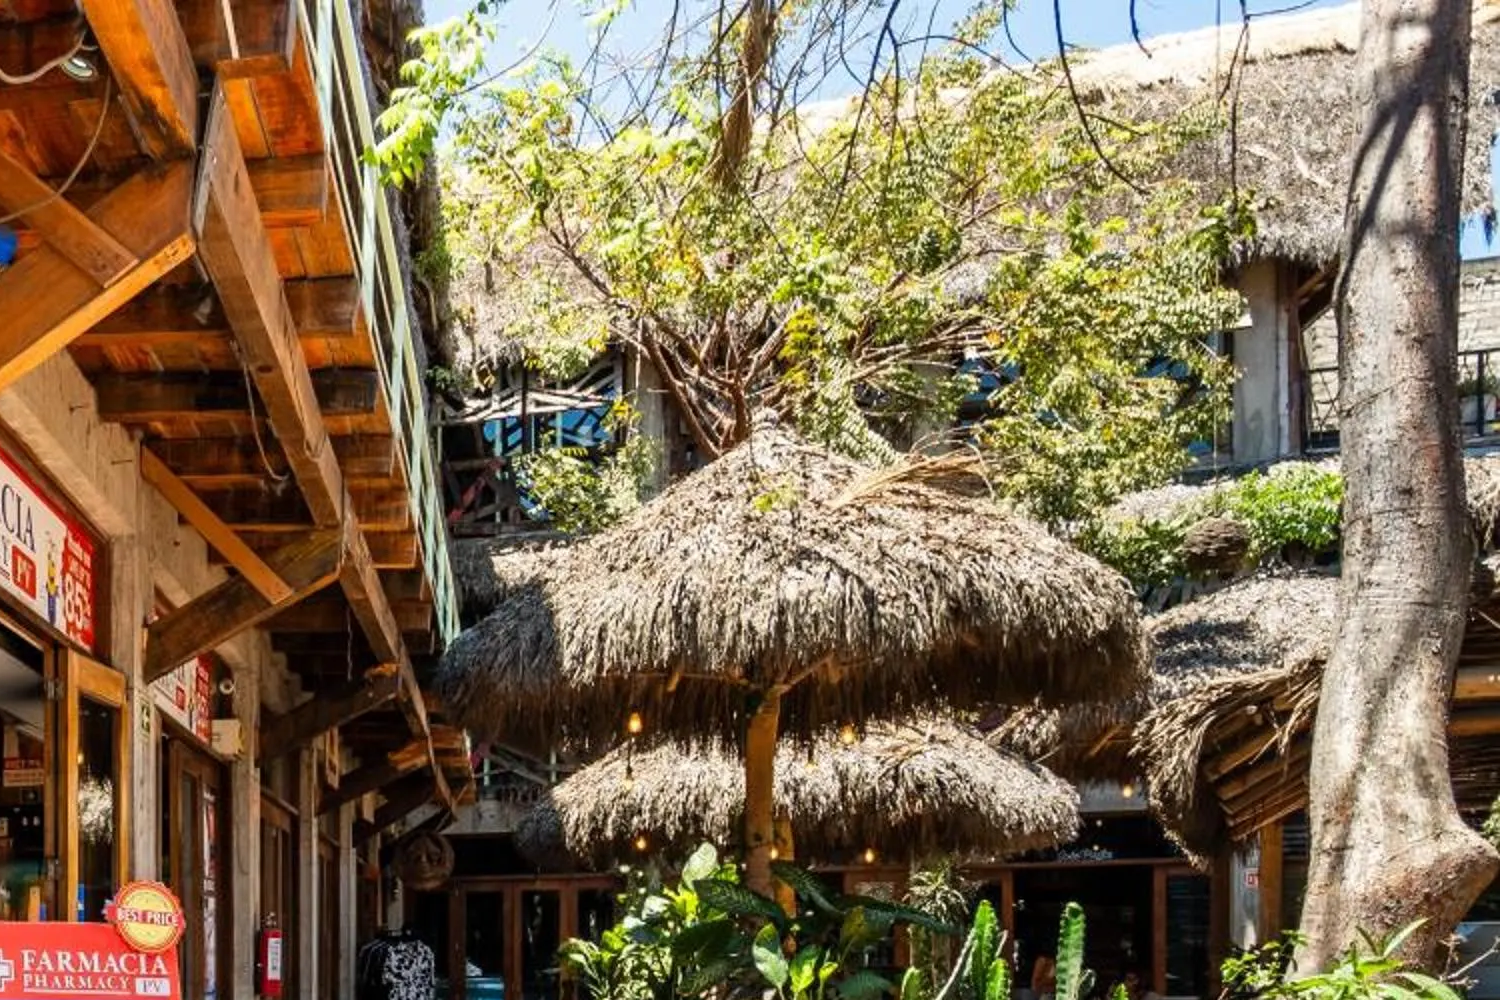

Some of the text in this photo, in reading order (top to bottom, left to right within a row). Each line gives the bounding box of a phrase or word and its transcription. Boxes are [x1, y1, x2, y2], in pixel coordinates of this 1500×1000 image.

[116, 908, 179, 927] BEST PRICE
[21, 950, 169, 976] FARMACIA
[23, 974, 130, 991] PHARMACY
[142, 980, 164, 994] PV
